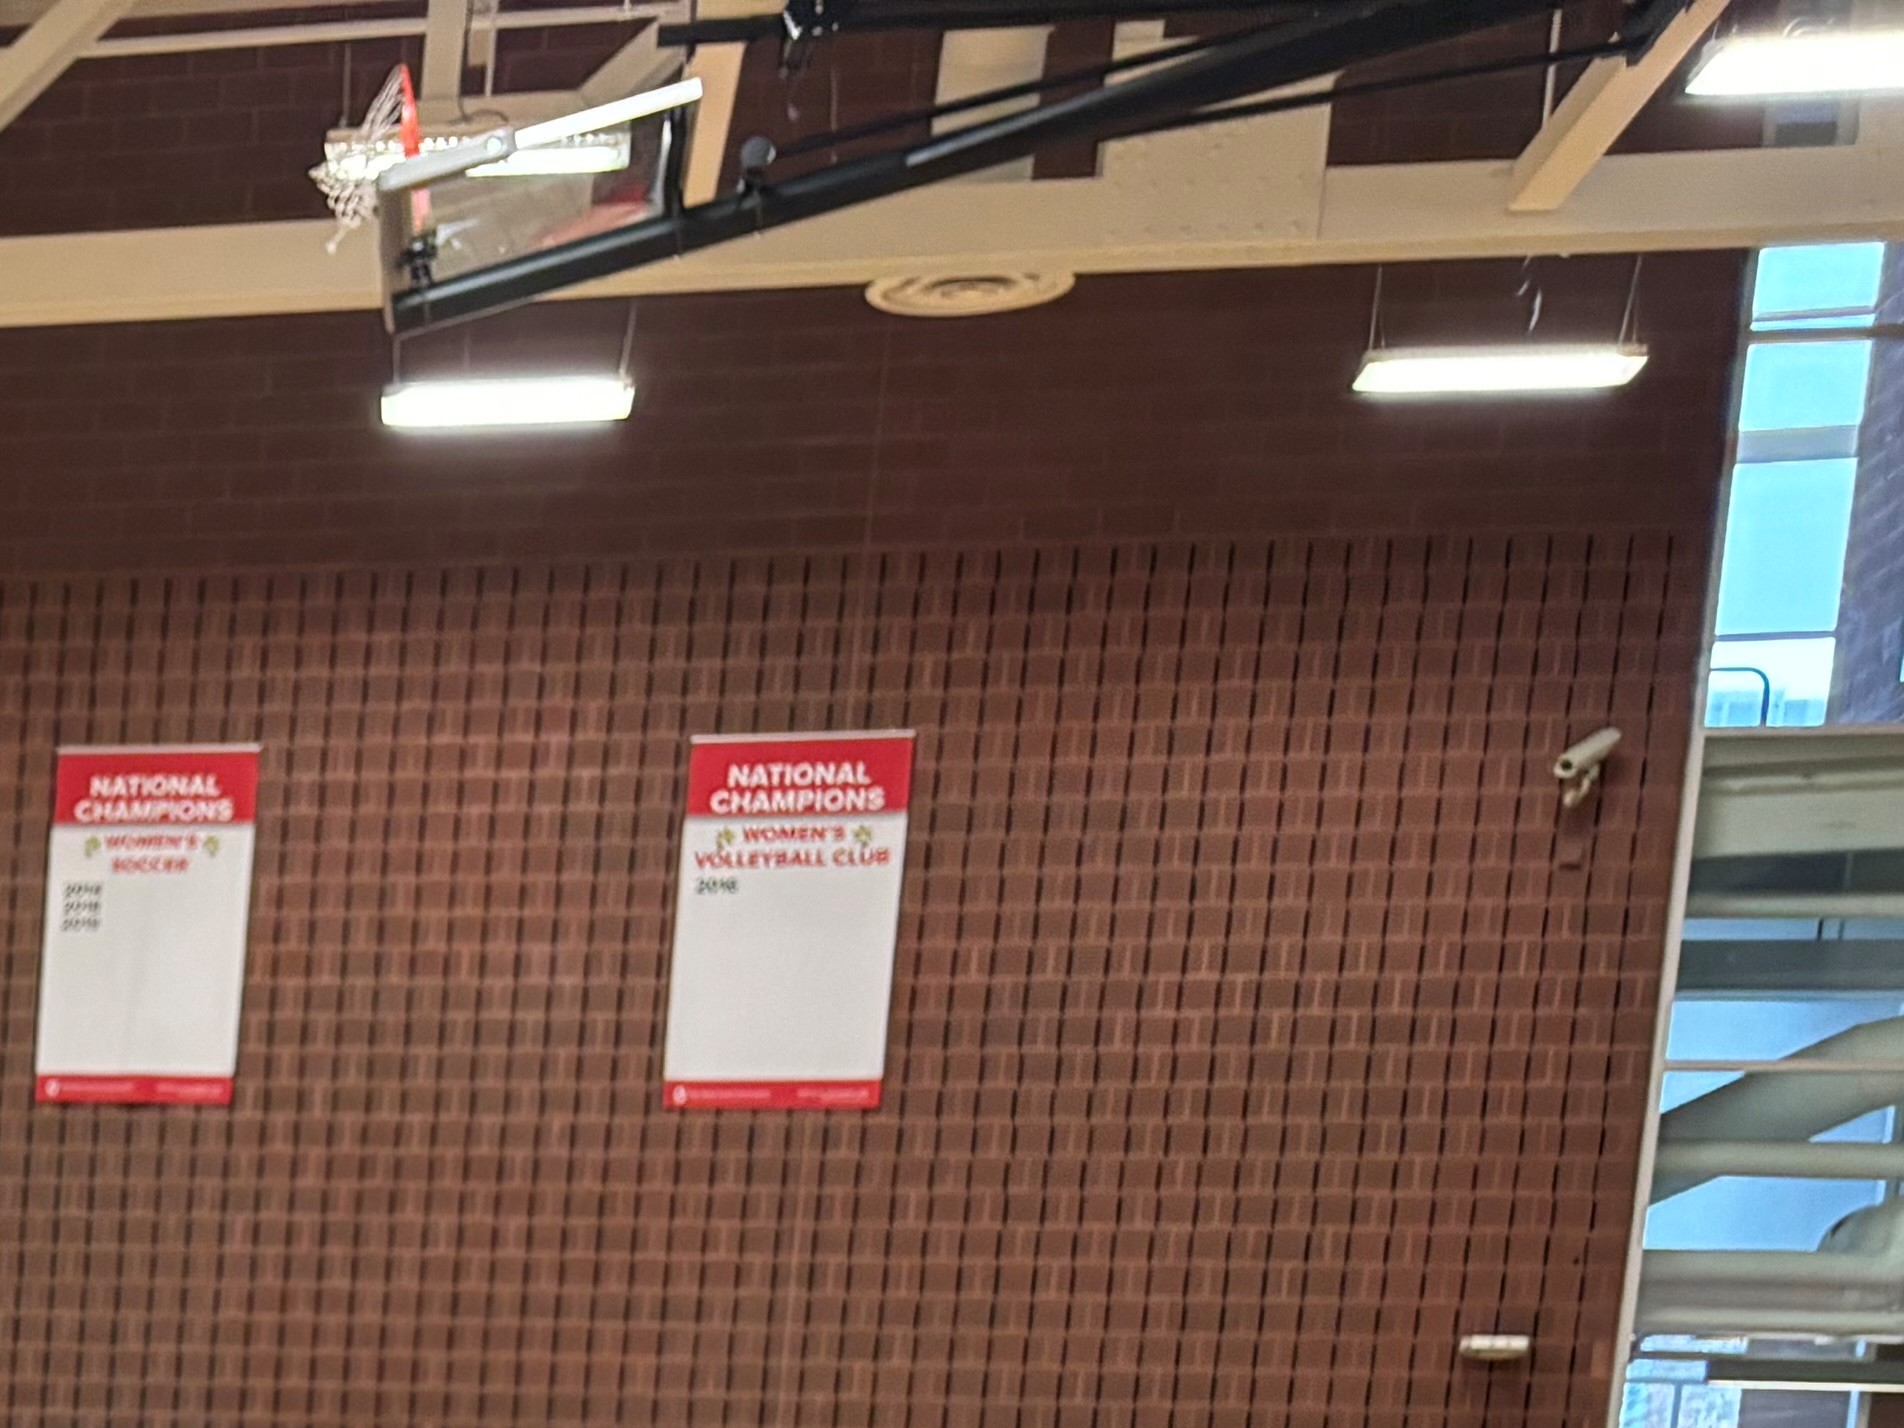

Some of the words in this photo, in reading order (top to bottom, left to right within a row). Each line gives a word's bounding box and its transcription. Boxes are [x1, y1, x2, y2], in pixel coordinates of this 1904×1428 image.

[726, 759, 872, 788] NATIONAL
[89, 773, 221, 798] NATIONAL
[73, 798, 235, 823] CHAMPIONS
[709, 786, 886, 815] CHAMPIONS
[104, 834, 198, 850] WOMEN'S
[743, 825, 846, 843] WOMEN'S
[111, 857, 190, 873] SOCCER
[695, 850, 826, 869] VOLLEYBALL
[833, 847, 890, 865] CLUB
